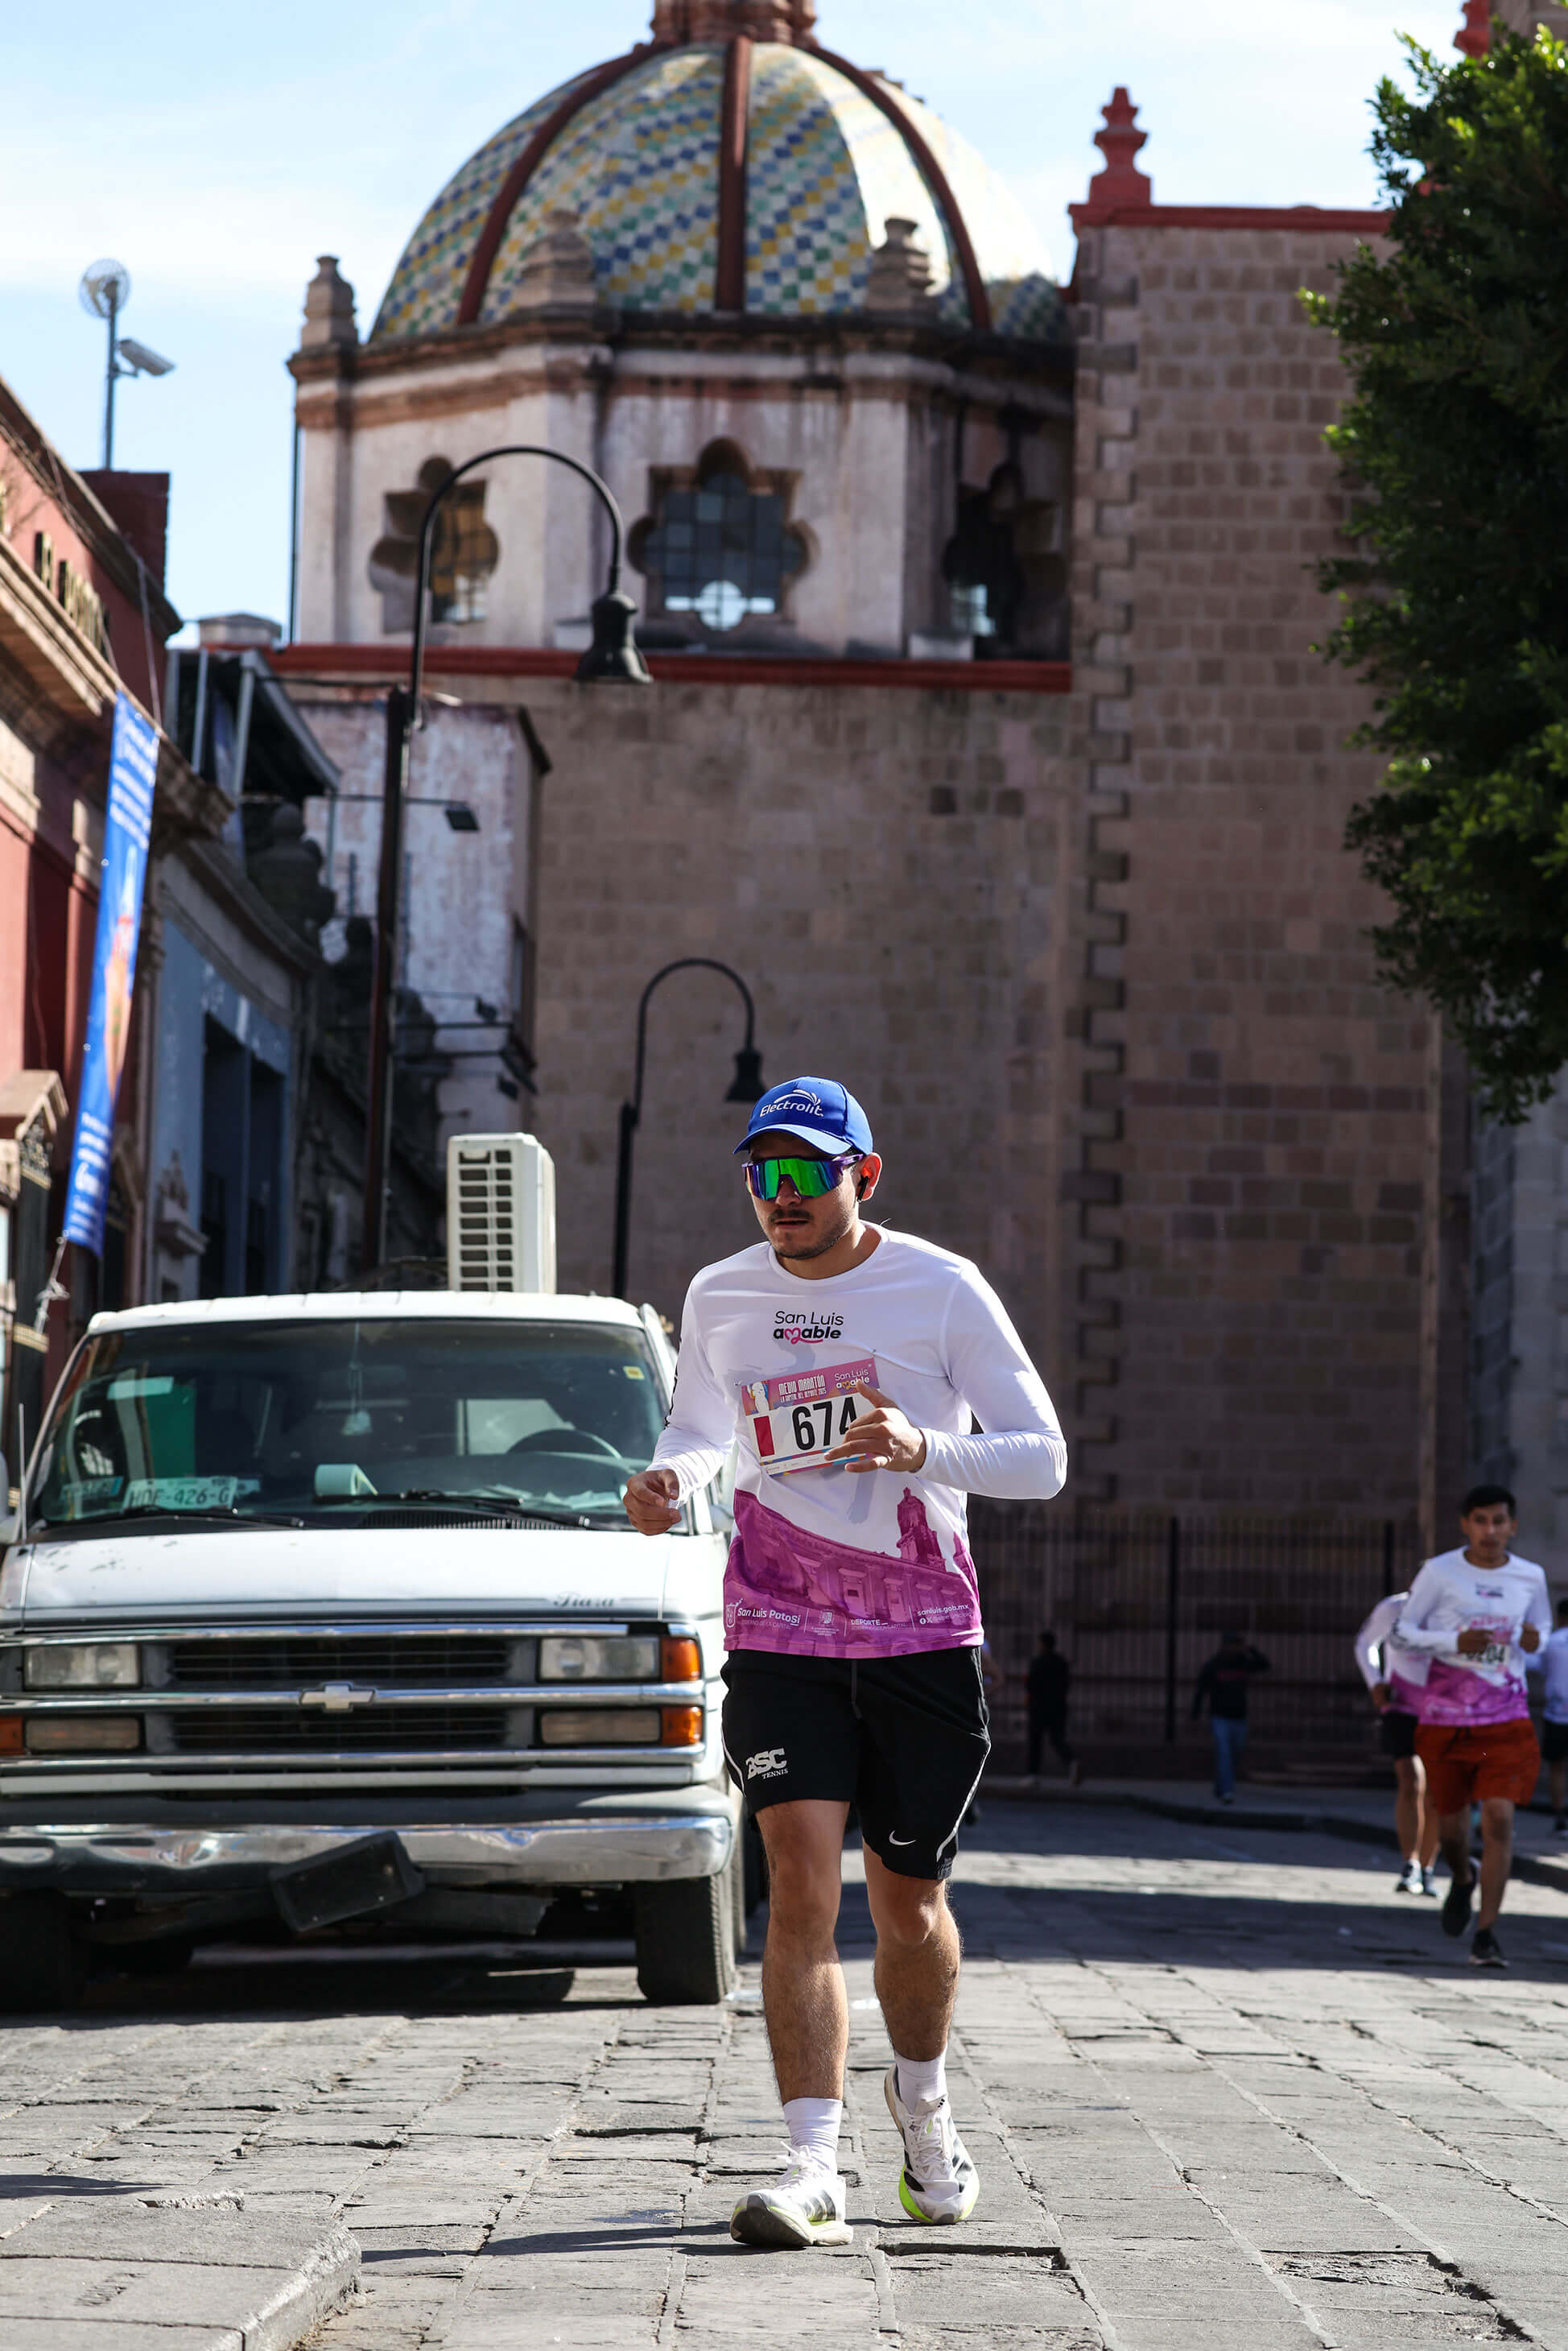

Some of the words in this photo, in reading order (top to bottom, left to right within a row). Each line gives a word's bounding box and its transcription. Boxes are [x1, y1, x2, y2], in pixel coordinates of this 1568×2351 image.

[760, 1101, 824, 1118] Electrolit
[774, 1311, 807, 1324] San
[810, 1311, 844, 1326] Luis
[834, 1372, 851, 1381] San
[851, 1369, 869, 1378] Luis
[778, 1381, 797, 1396] MEDIO
[798, 1374, 826, 1392] MARATÓN
[792, 1396, 858, 1451] 674
[737, 1607, 752, 1617] San
[752, 1608, 768, 1618] Luis
[917, 1604, 970, 1617] sanluis.gob.mx
[850, 1618, 881, 1626] DEPORTE
[745, 1748, 787, 1780] BSC
[761, 1768, 789, 1779] TENNIS
